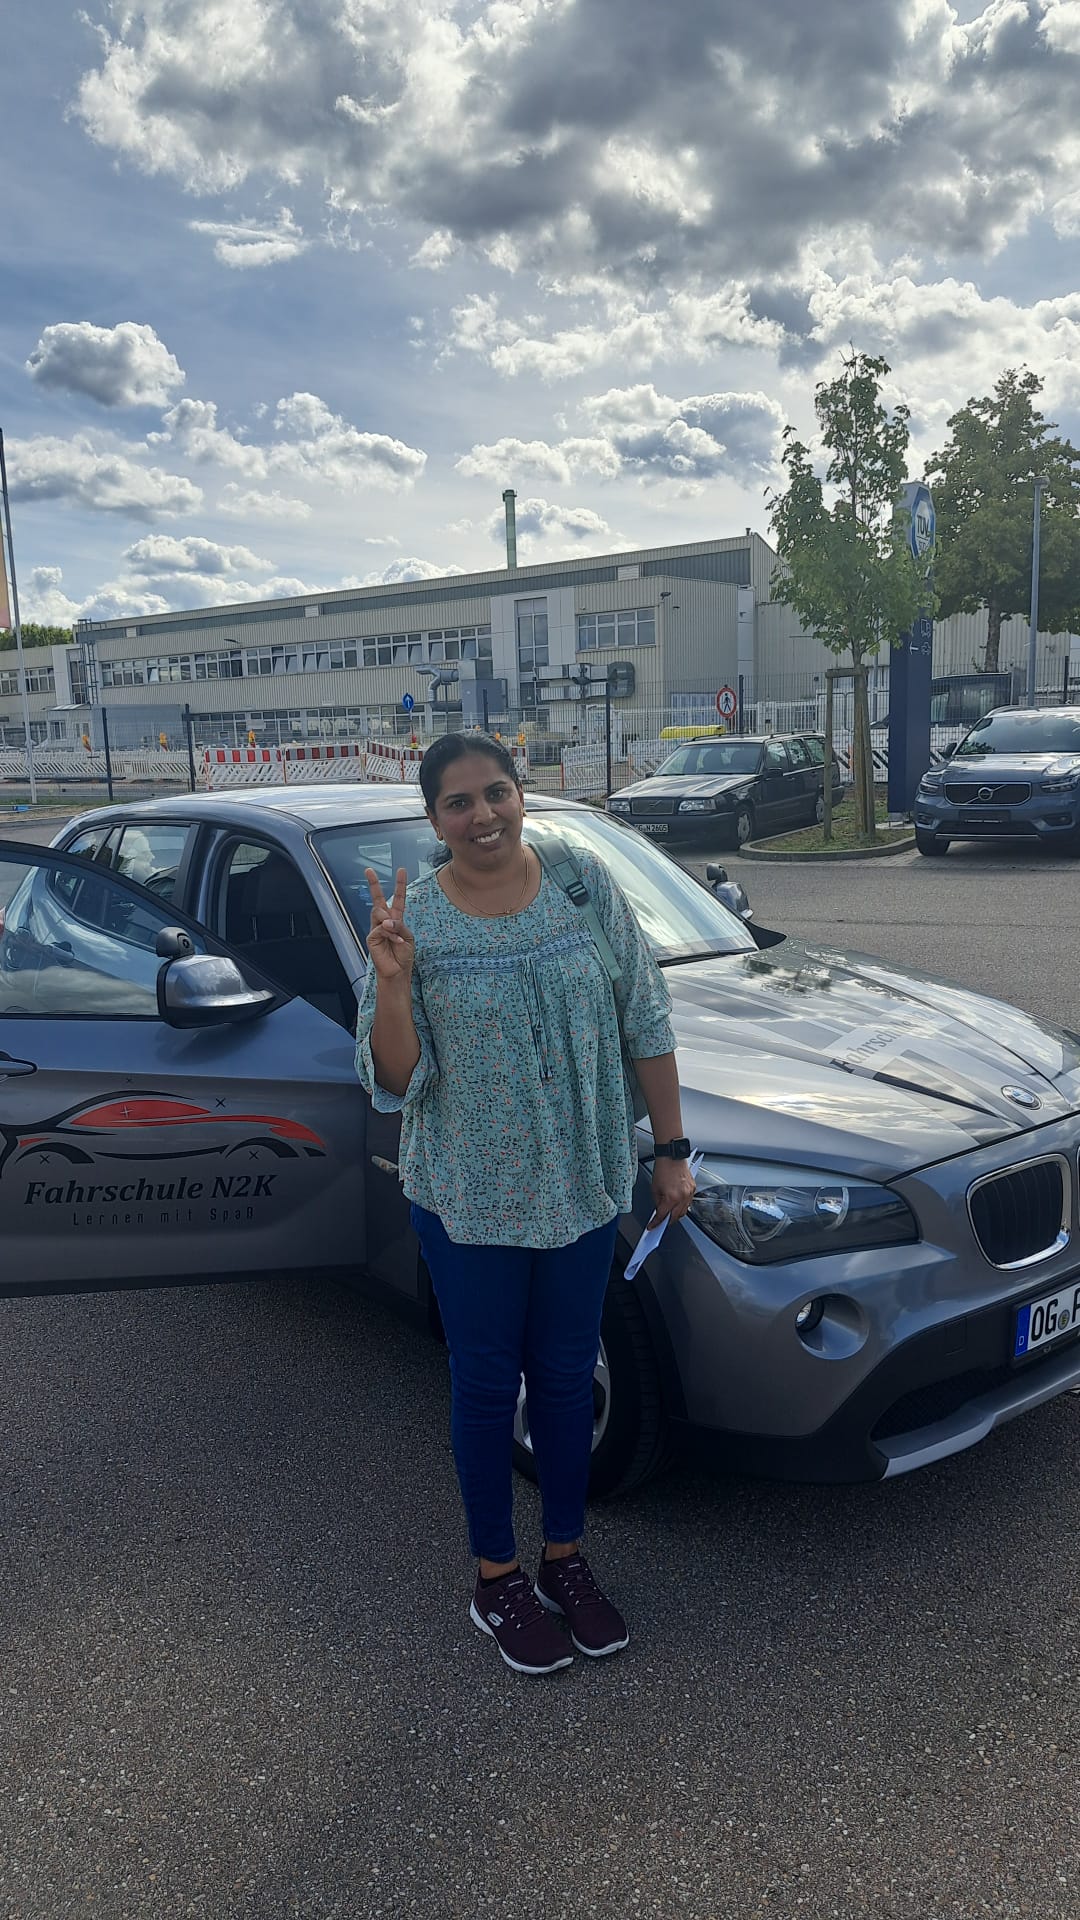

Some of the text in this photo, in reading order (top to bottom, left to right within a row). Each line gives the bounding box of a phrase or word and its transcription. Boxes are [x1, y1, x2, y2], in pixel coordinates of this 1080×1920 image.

[24, 1174, 278, 1204] Fahrschule N2K
[73, 1210, 145, 1226] Lernen
[160, 1208, 193, 1224] mit
